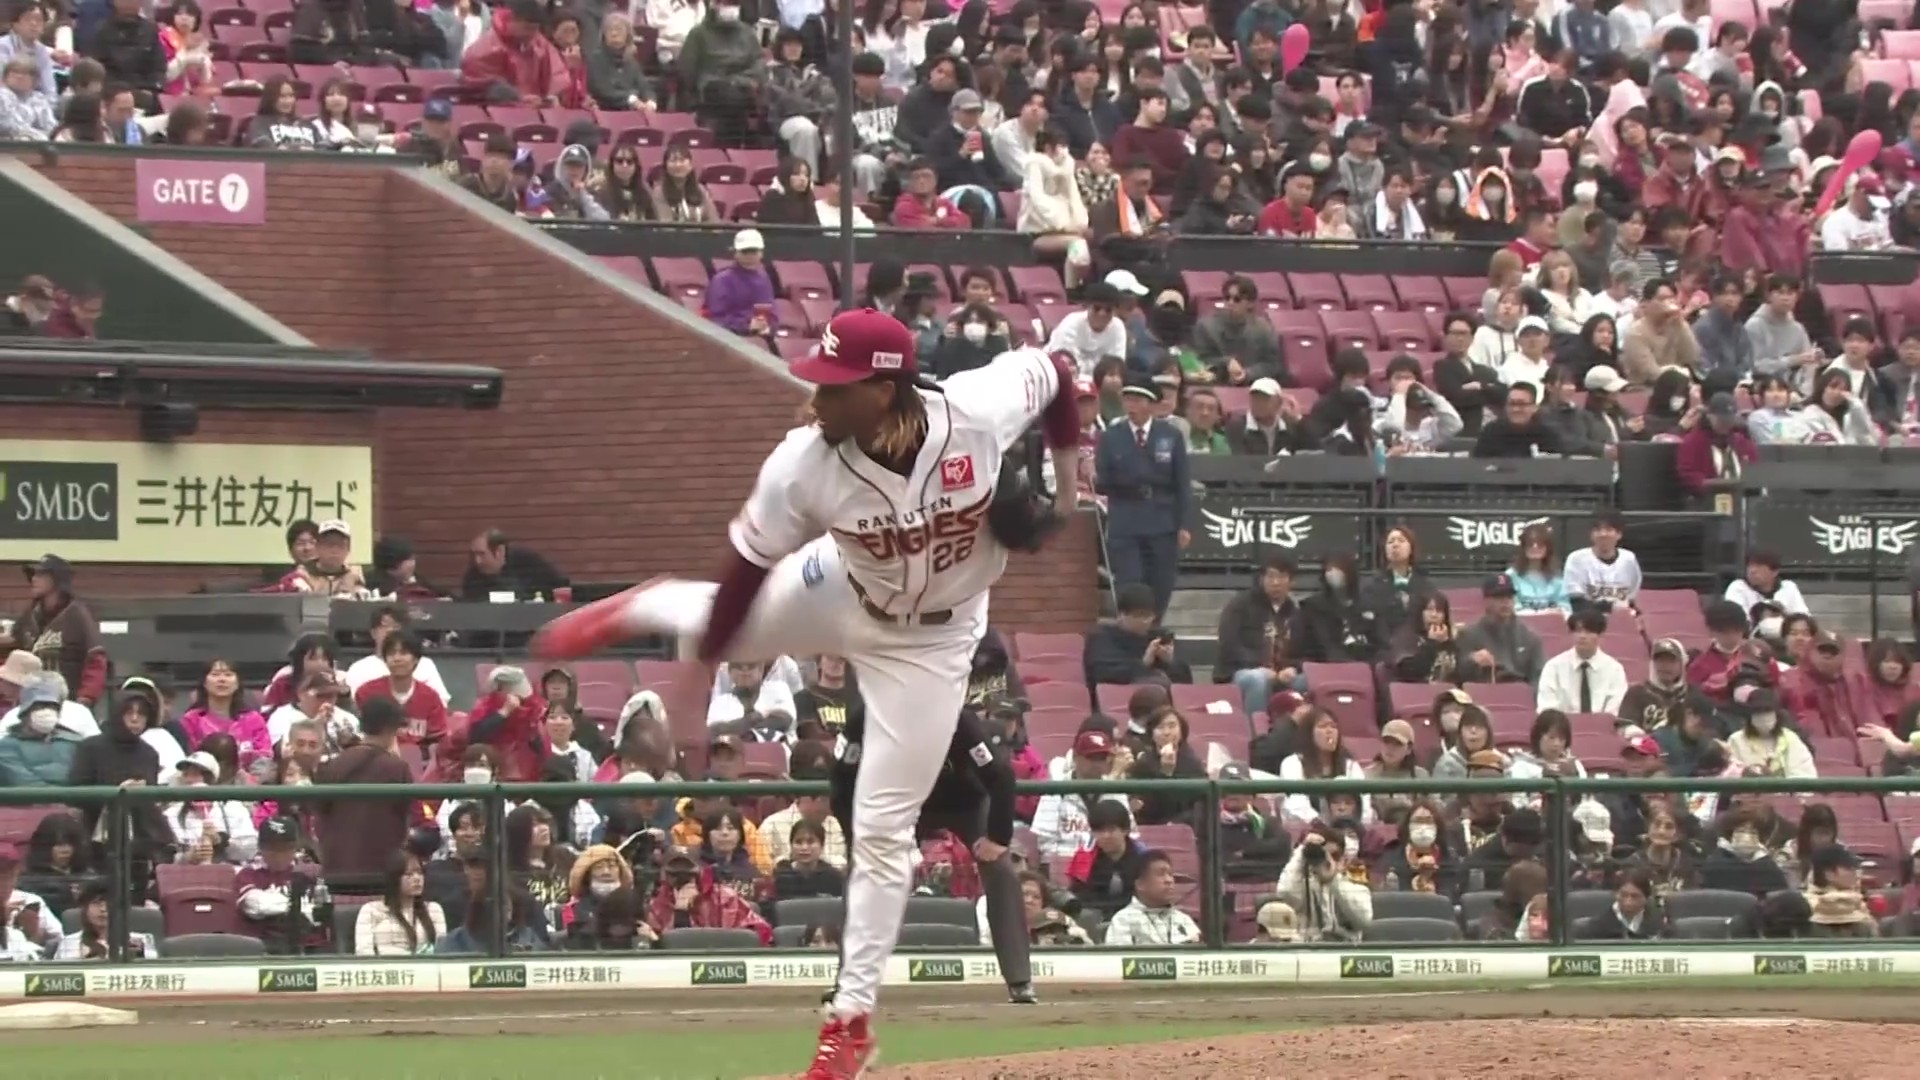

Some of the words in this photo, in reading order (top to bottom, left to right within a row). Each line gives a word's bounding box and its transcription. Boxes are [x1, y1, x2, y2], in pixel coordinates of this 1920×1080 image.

[153, 178, 214, 204] GATE
[229, 181, 239, 204] 7
[16, 481, 110, 522] SMBC
[136, 475, 358, 527] 三井住友カード
[1453, 517, 1534, 549] EAGLE
[708, 965, 744, 979] SMBC
[925, 962, 961, 977] SMBC
[970, 960, 1054, 977] 三井銀行
[1138, 961, 1174, 976] SMBC
[1356, 959, 1391, 974] SMBC
[1563, 958, 1599, 974] SMBC
[277, 972, 314, 987] SMBC
[486, 968, 523, 984] SMBC
[43, 977, 82, 992] SMBC
